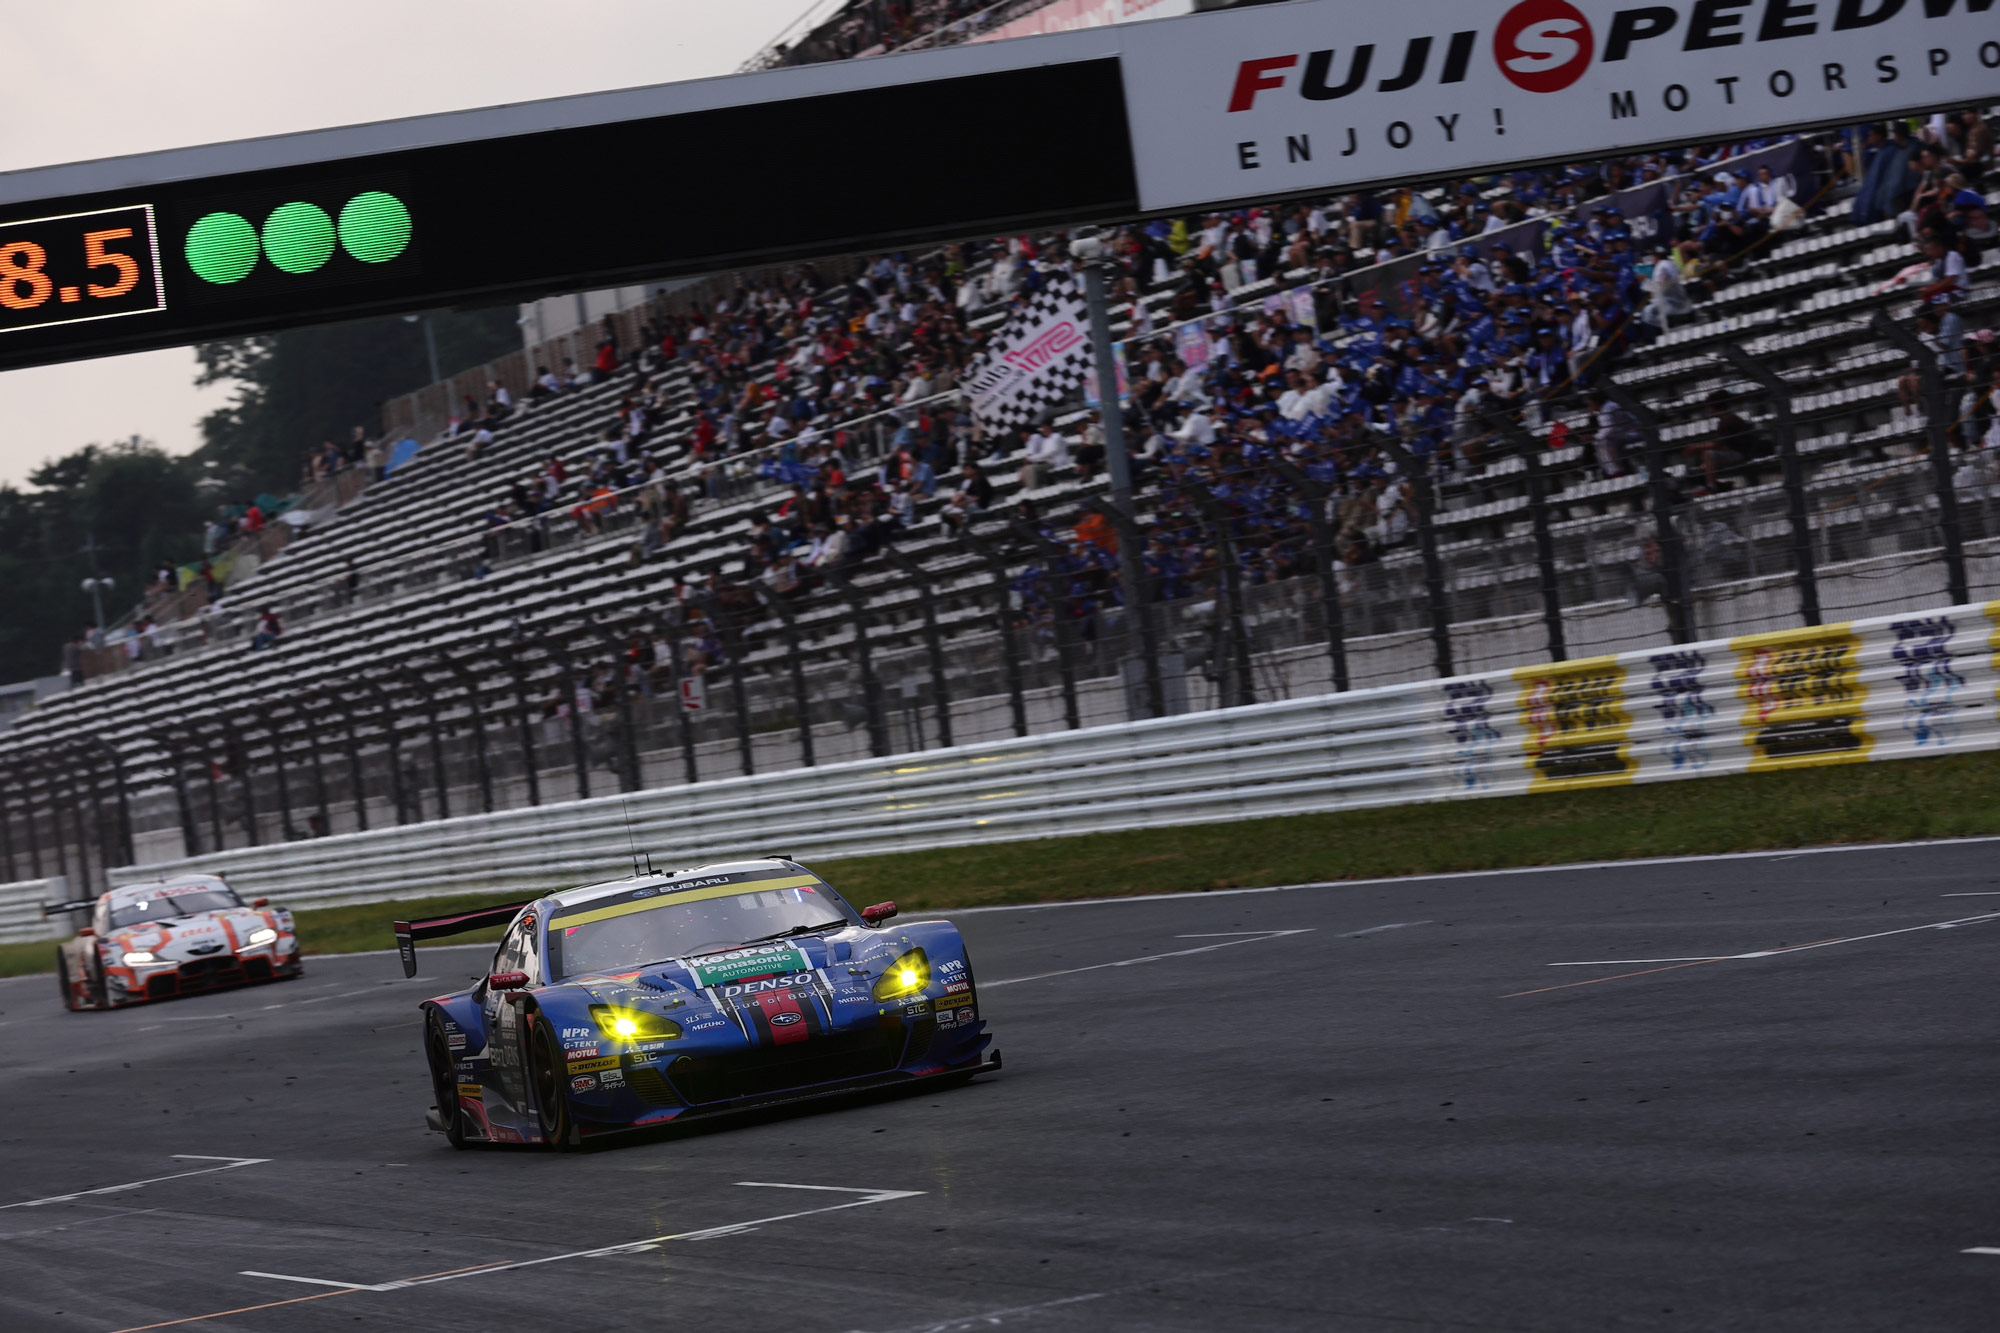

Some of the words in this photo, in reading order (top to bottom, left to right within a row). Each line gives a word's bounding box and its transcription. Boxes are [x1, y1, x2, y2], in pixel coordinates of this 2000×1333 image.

[1227, 30, 1478, 112] FUJI
[1236, 108, 1506, 170] ENJOY!
[658, 876, 730, 893] SUBARU
[690, 945, 786, 968] KeePer
[705, 954, 792, 975] Panasonic
[722, 963, 783, 978] AUTOMOTIVE
[938, 959, 965, 974] NPR
[940, 973, 968, 985] G-TEKT
[724, 973, 813, 999] DENSO
[946, 981, 970, 993] MOTUL
[943, 995, 971, 1007] DUNLOP
[906, 1003, 926, 1015] STC
[685, 1014, 700, 1025] SLS
[692, 1020, 725, 1032] MIZUHO
[562, 1027, 590, 1039] NPR
[563, 1040, 598, 1050] G-TEKT
[567, 1048, 598, 1060] MOTUL
[633, 1051, 658, 1063] STC
[577, 1059, 616, 1071] DUNLOP
[573, 1079, 595, 1089] BMC
